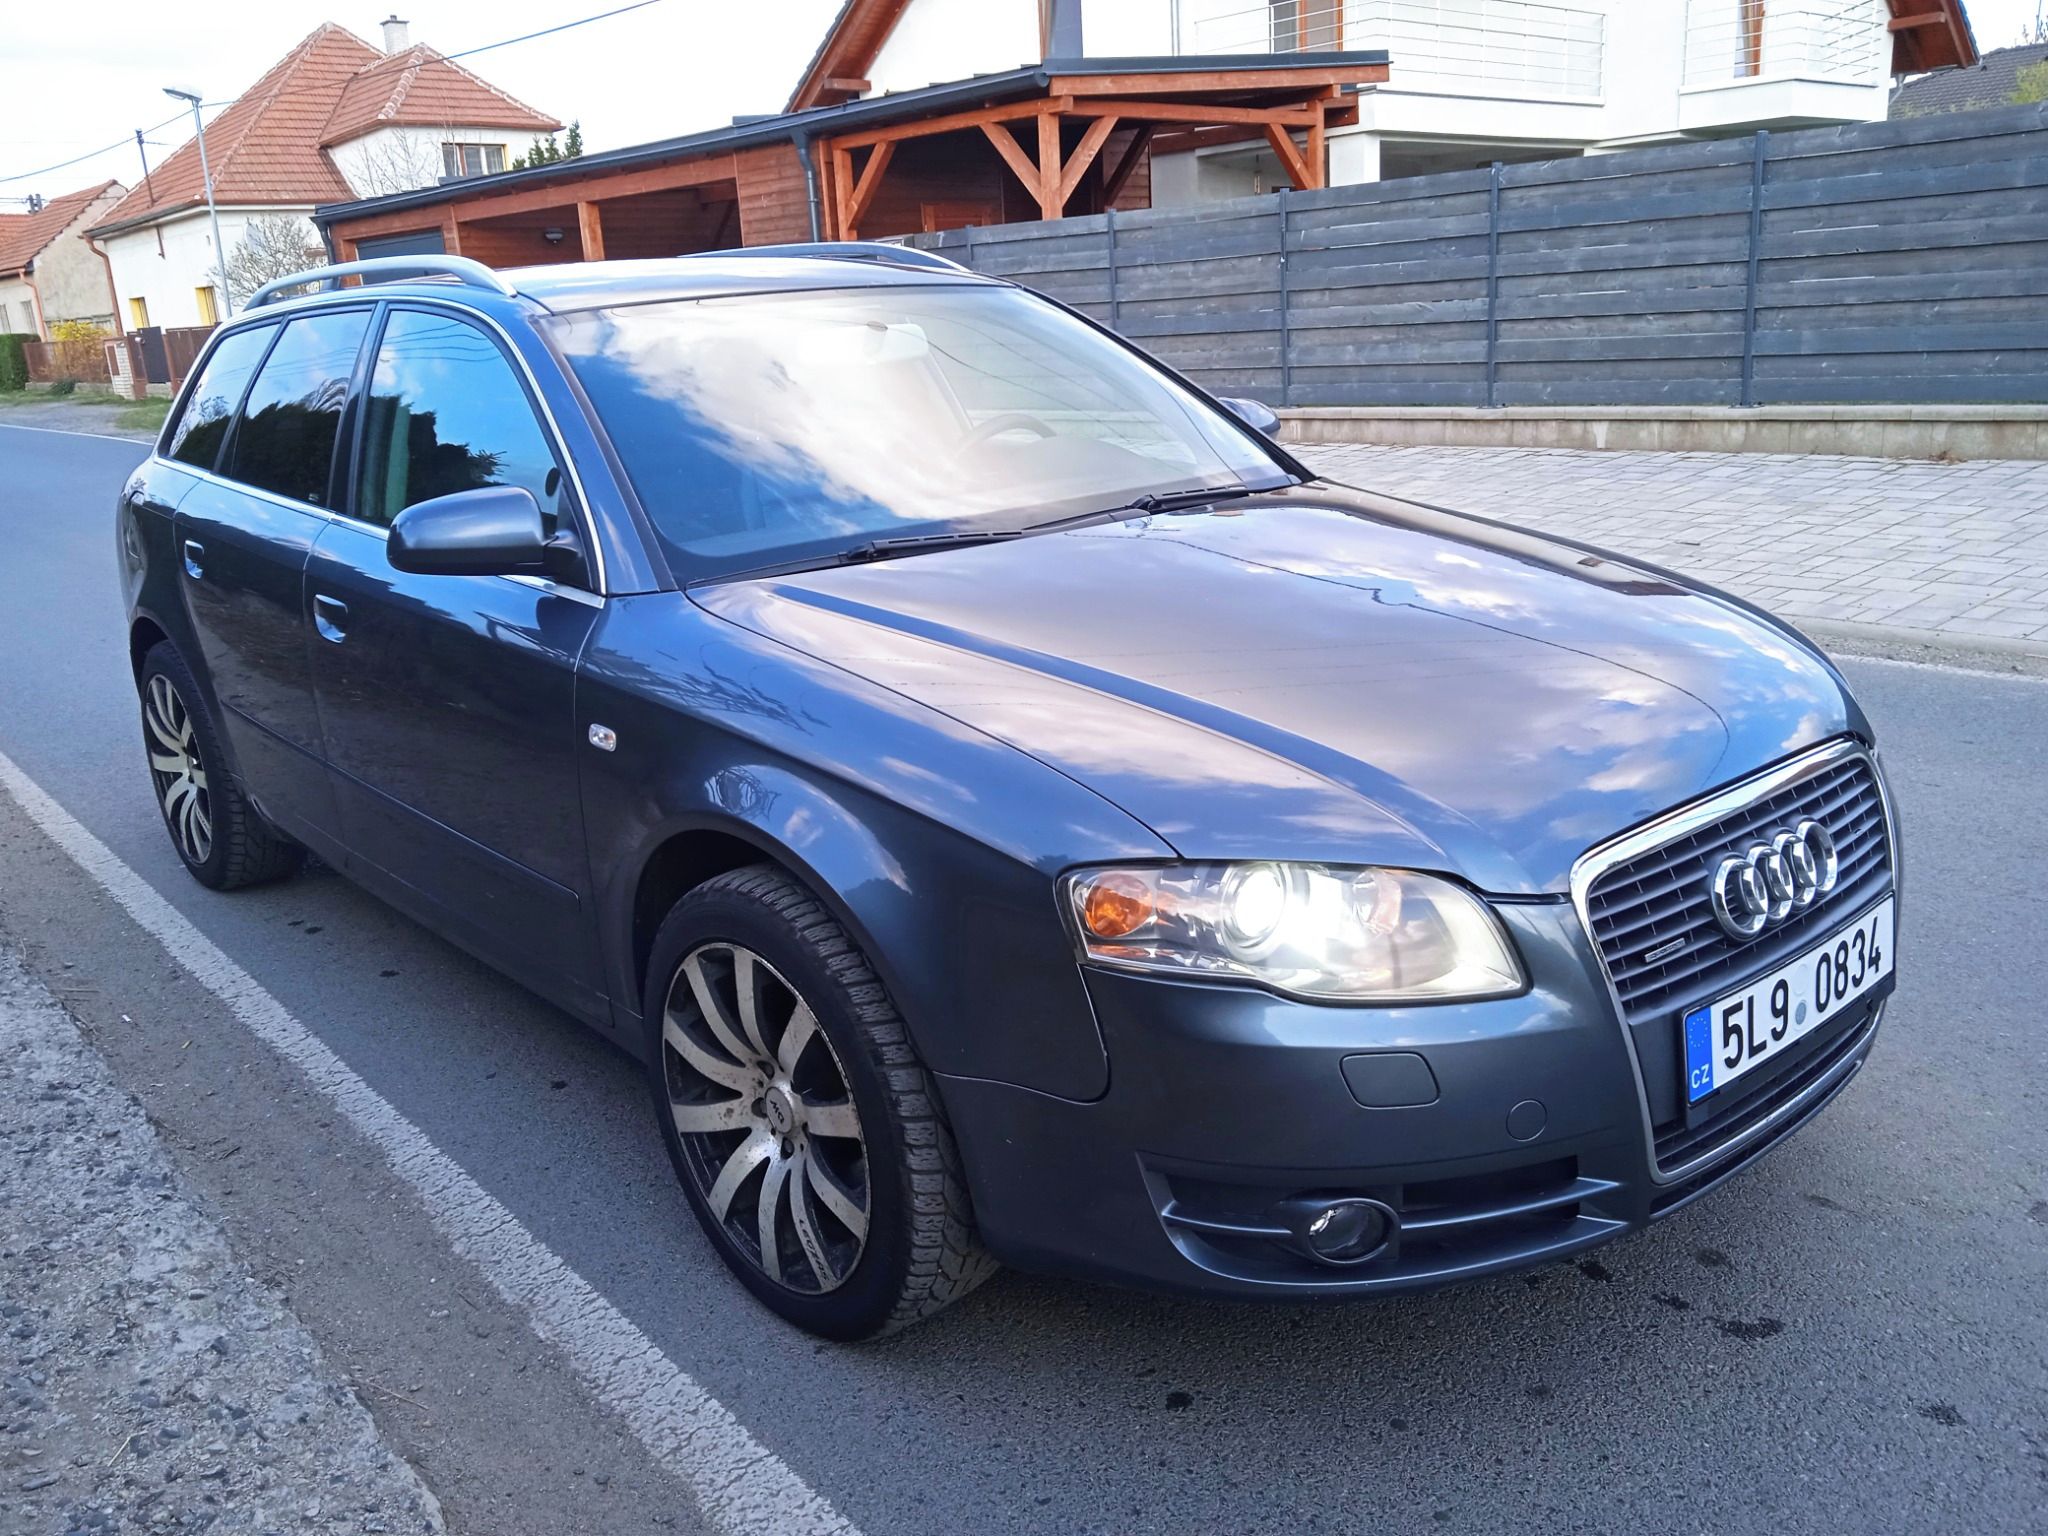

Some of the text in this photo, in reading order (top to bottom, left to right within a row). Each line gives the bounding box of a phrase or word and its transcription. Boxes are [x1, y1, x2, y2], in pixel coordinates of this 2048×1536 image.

[1722, 916, 1881, 1069] 5L9 0834
[1691, 1063, 1710, 1089] CZ
